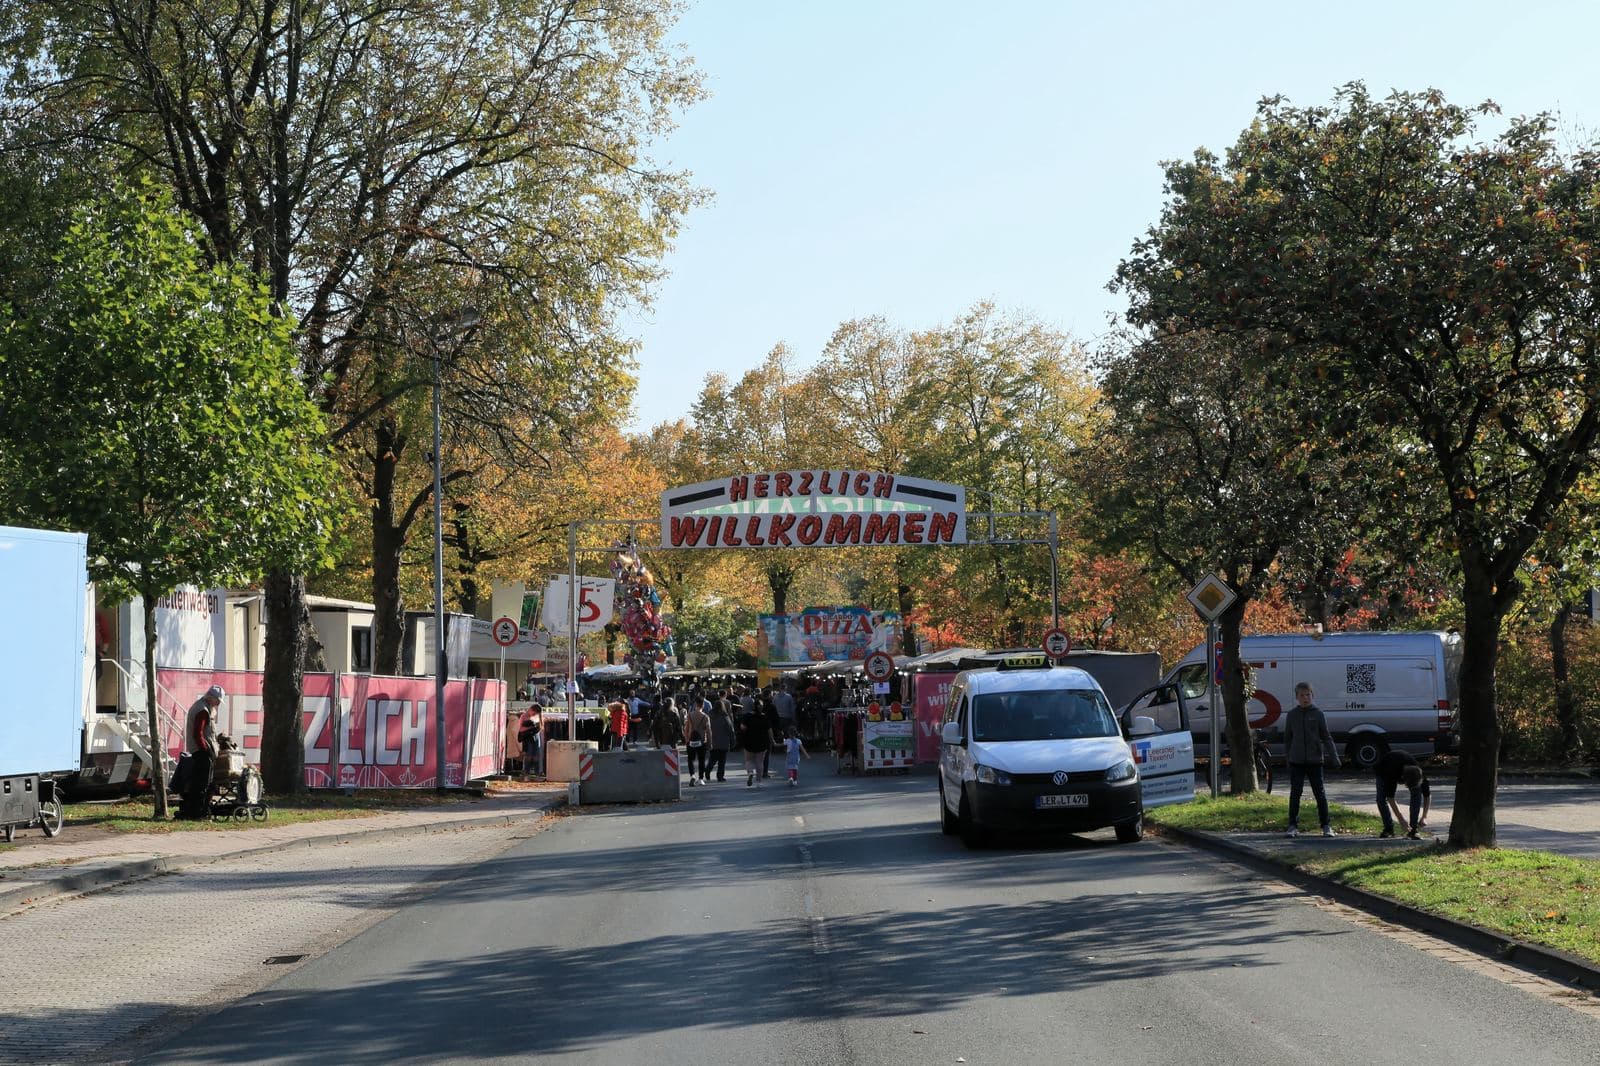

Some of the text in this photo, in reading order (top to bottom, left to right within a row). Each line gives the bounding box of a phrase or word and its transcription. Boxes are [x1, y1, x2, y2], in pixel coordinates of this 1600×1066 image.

[729, 471, 894, 501] HERZLICH
[670, 512, 957, 546] WILLKOMMEN
[804, 614, 873, 634] PIZZA
[1012, 657, 1037, 665] TAXI
